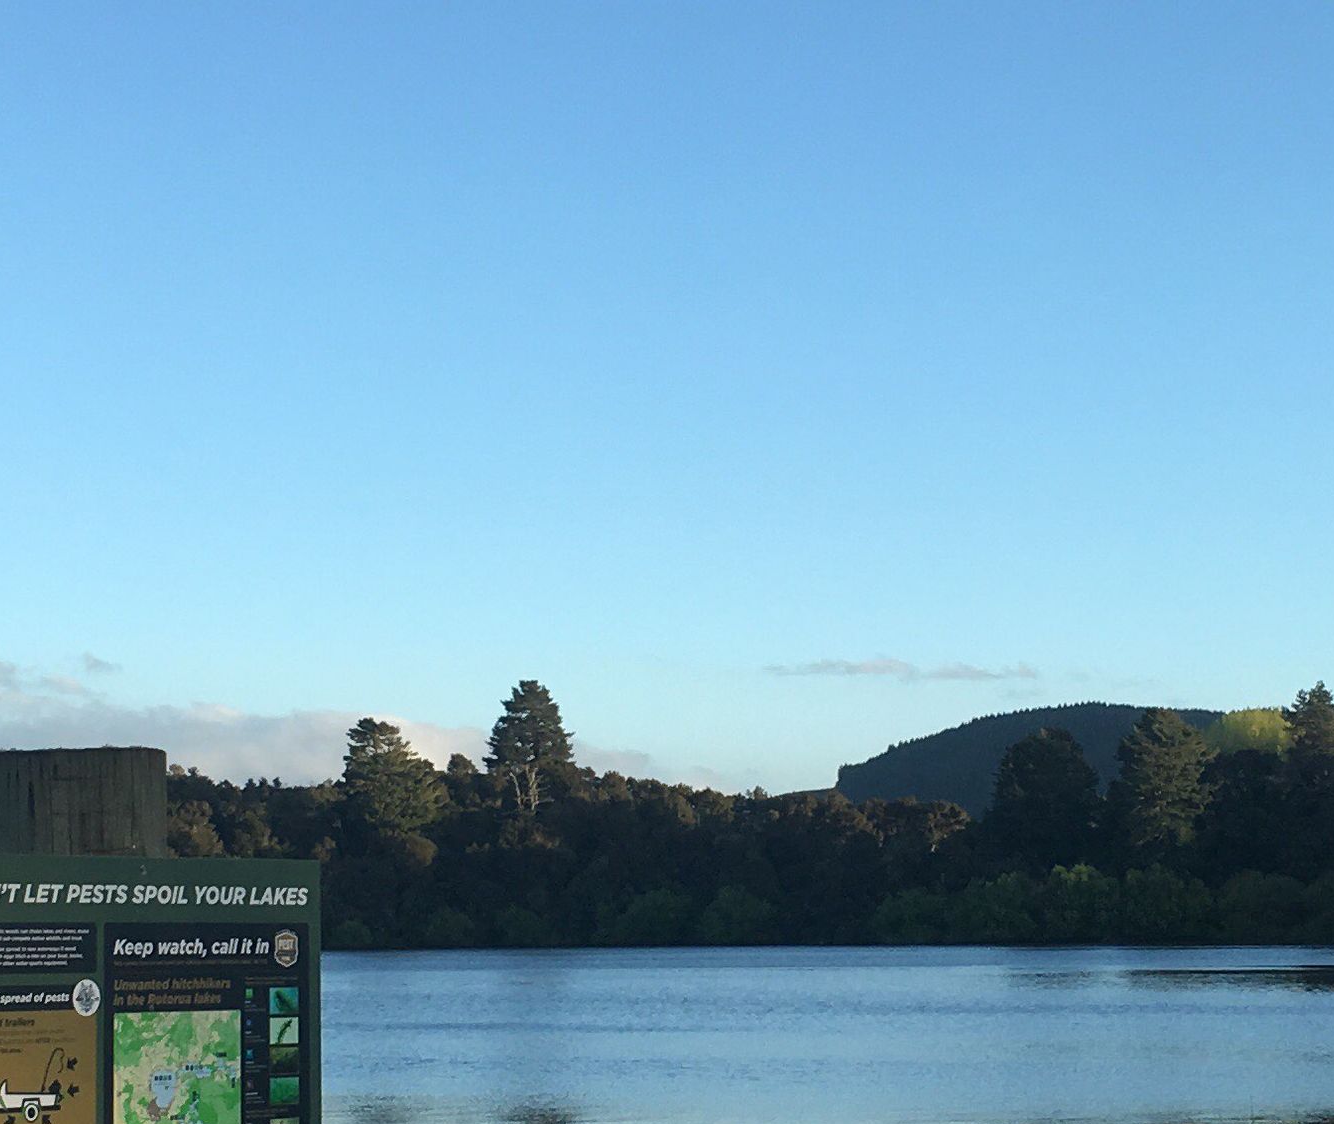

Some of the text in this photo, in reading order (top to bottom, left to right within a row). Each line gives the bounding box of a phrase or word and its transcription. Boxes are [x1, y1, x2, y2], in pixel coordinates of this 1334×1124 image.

[23, 883, 64, 904] LET
[65, 884, 128, 904] PESTS
[132, 885, 188, 905] SPOIL
[194, 886, 247, 905] YOUR
[249, 887, 309, 906] LAKES
[113, 937, 270, 958] Keep watch, call it in
[114, 978, 169, 991] Unwanted
[170, 977, 231, 991] hitchhikers
[0, 993, 33, 1005] spread
[34, 992, 44, 1003] of
[44, 993, 70, 1004] pests
[113, 994, 222, 1006] in the Rotorua lakes
[5, 1017, 36, 1027] trailers
